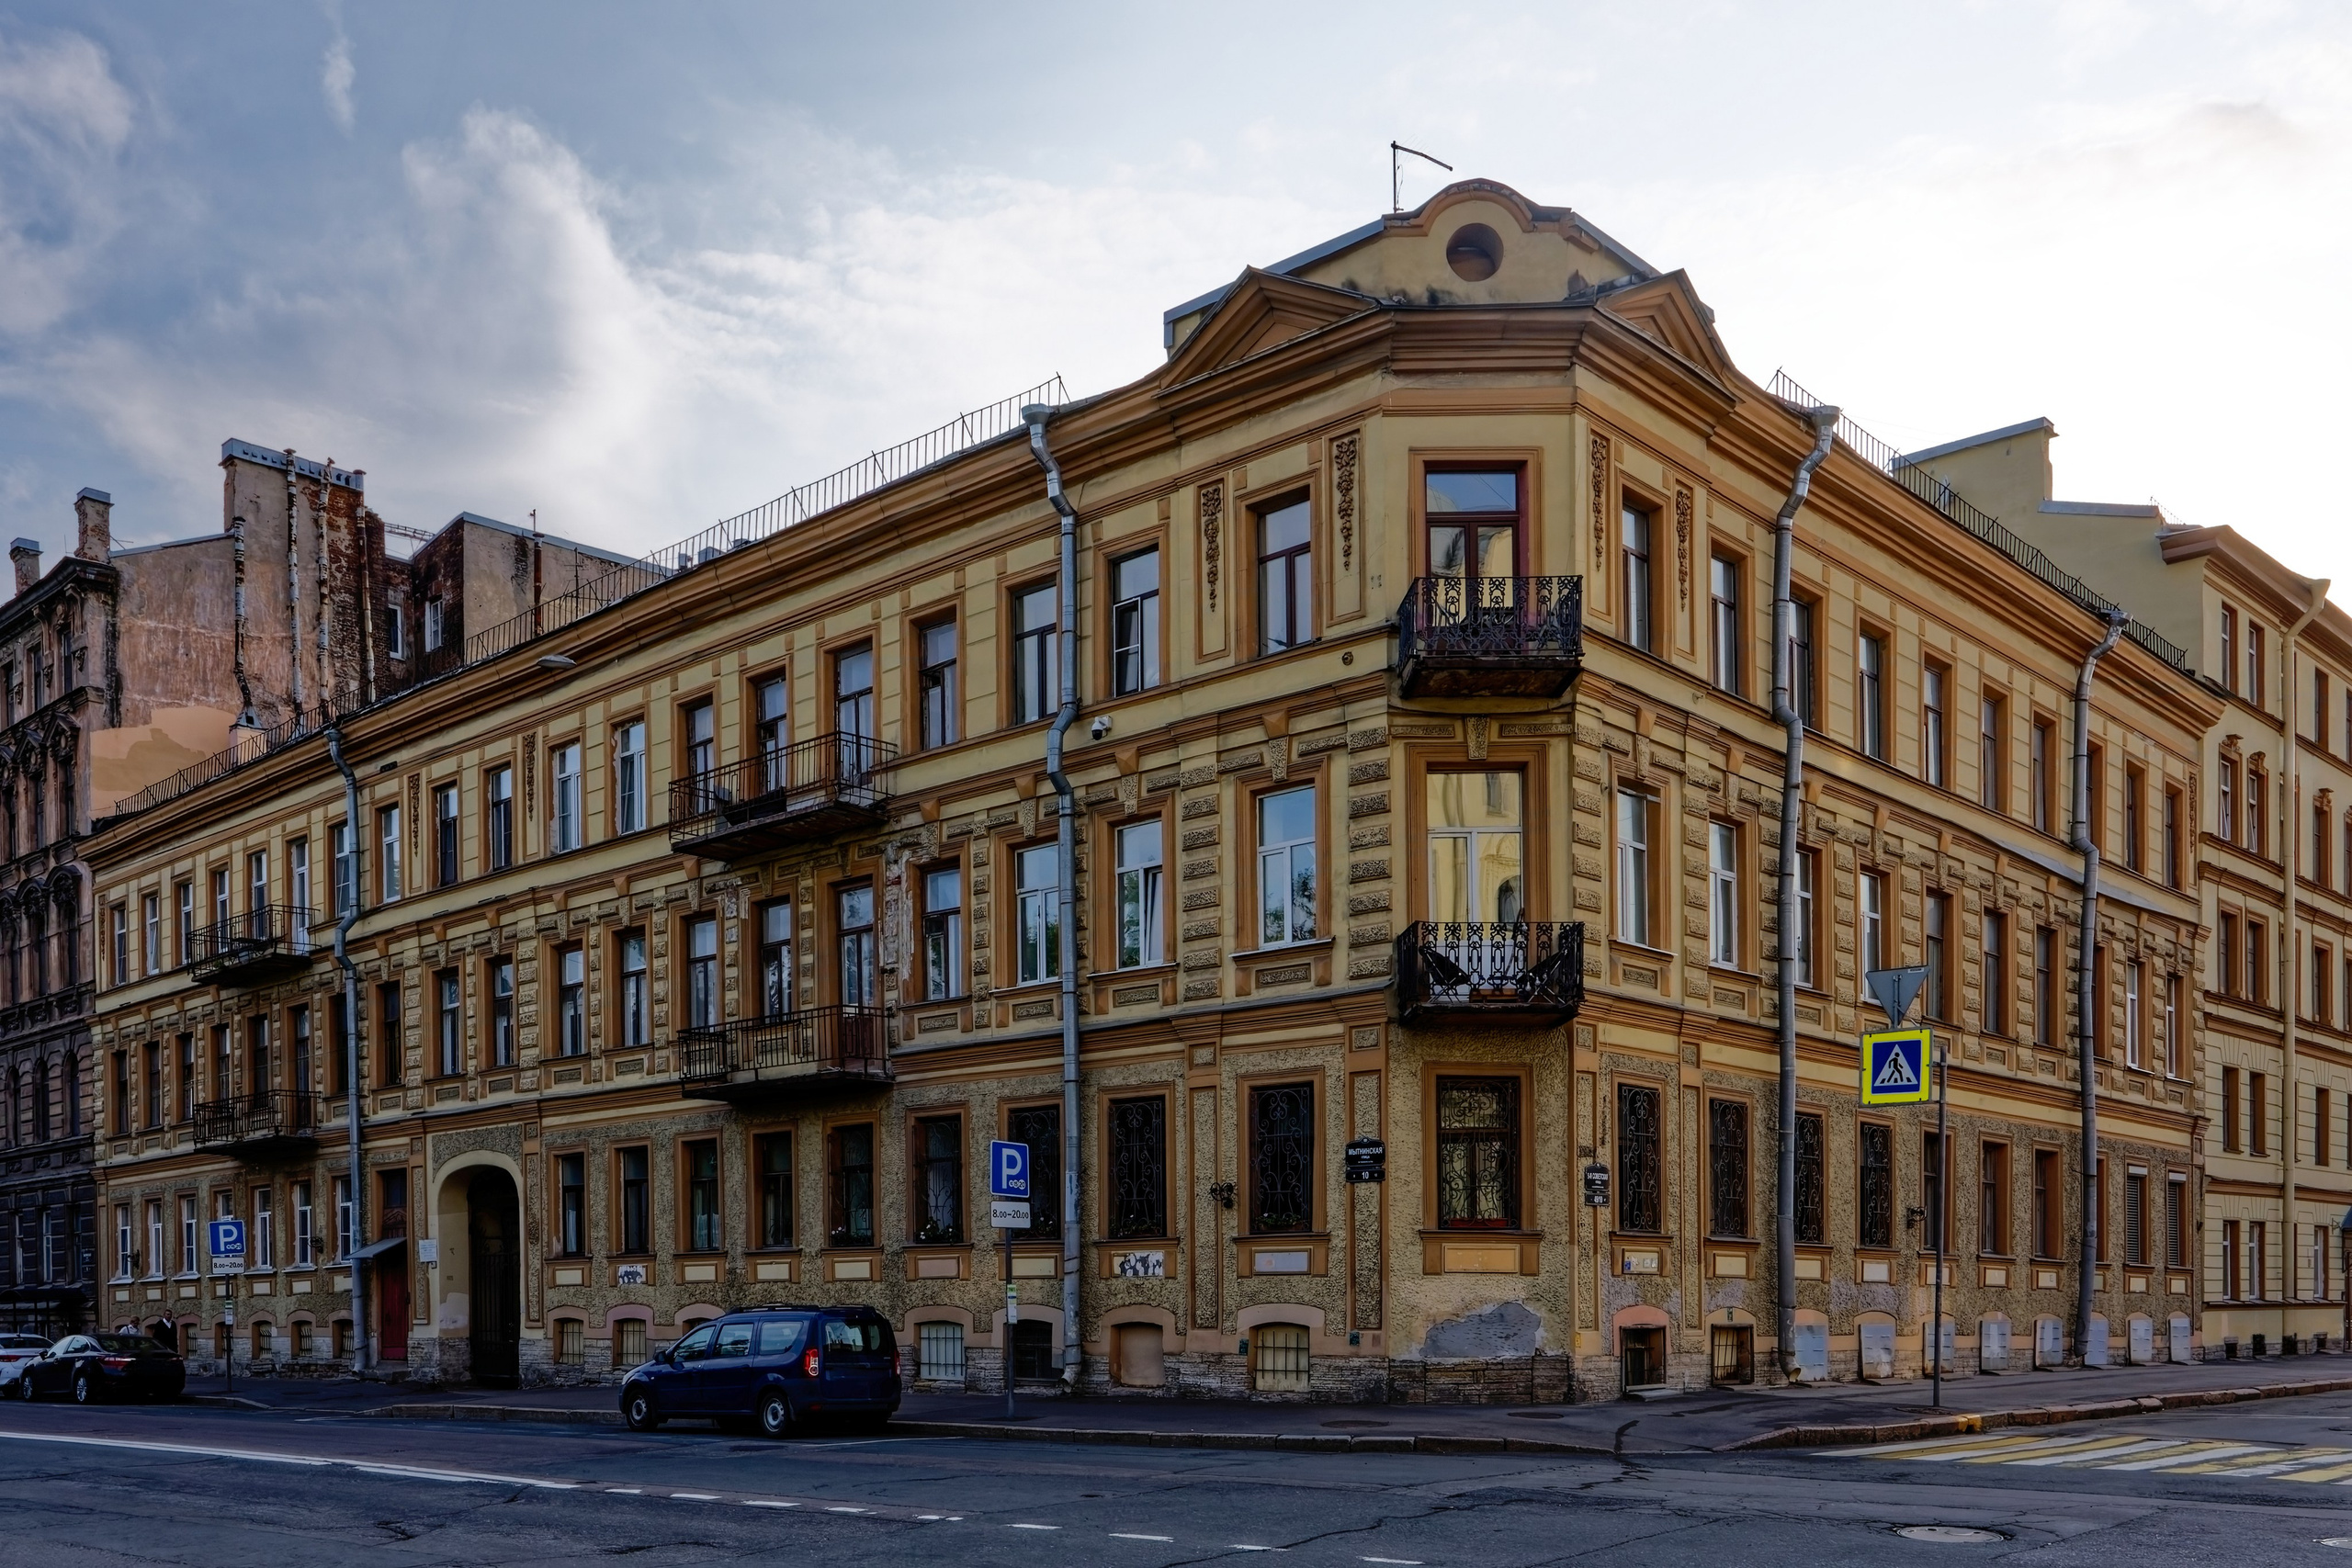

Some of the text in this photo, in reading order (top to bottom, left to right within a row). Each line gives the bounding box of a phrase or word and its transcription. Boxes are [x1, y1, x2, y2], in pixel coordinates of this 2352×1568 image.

[1348, 1147, 1383, 1156] МЫТНИНСКАЯ
[1001, 1147, 1022, 1189] P
[1362, 1171, 1369, 1179] 10
[219, 1225, 238, 1251] P
